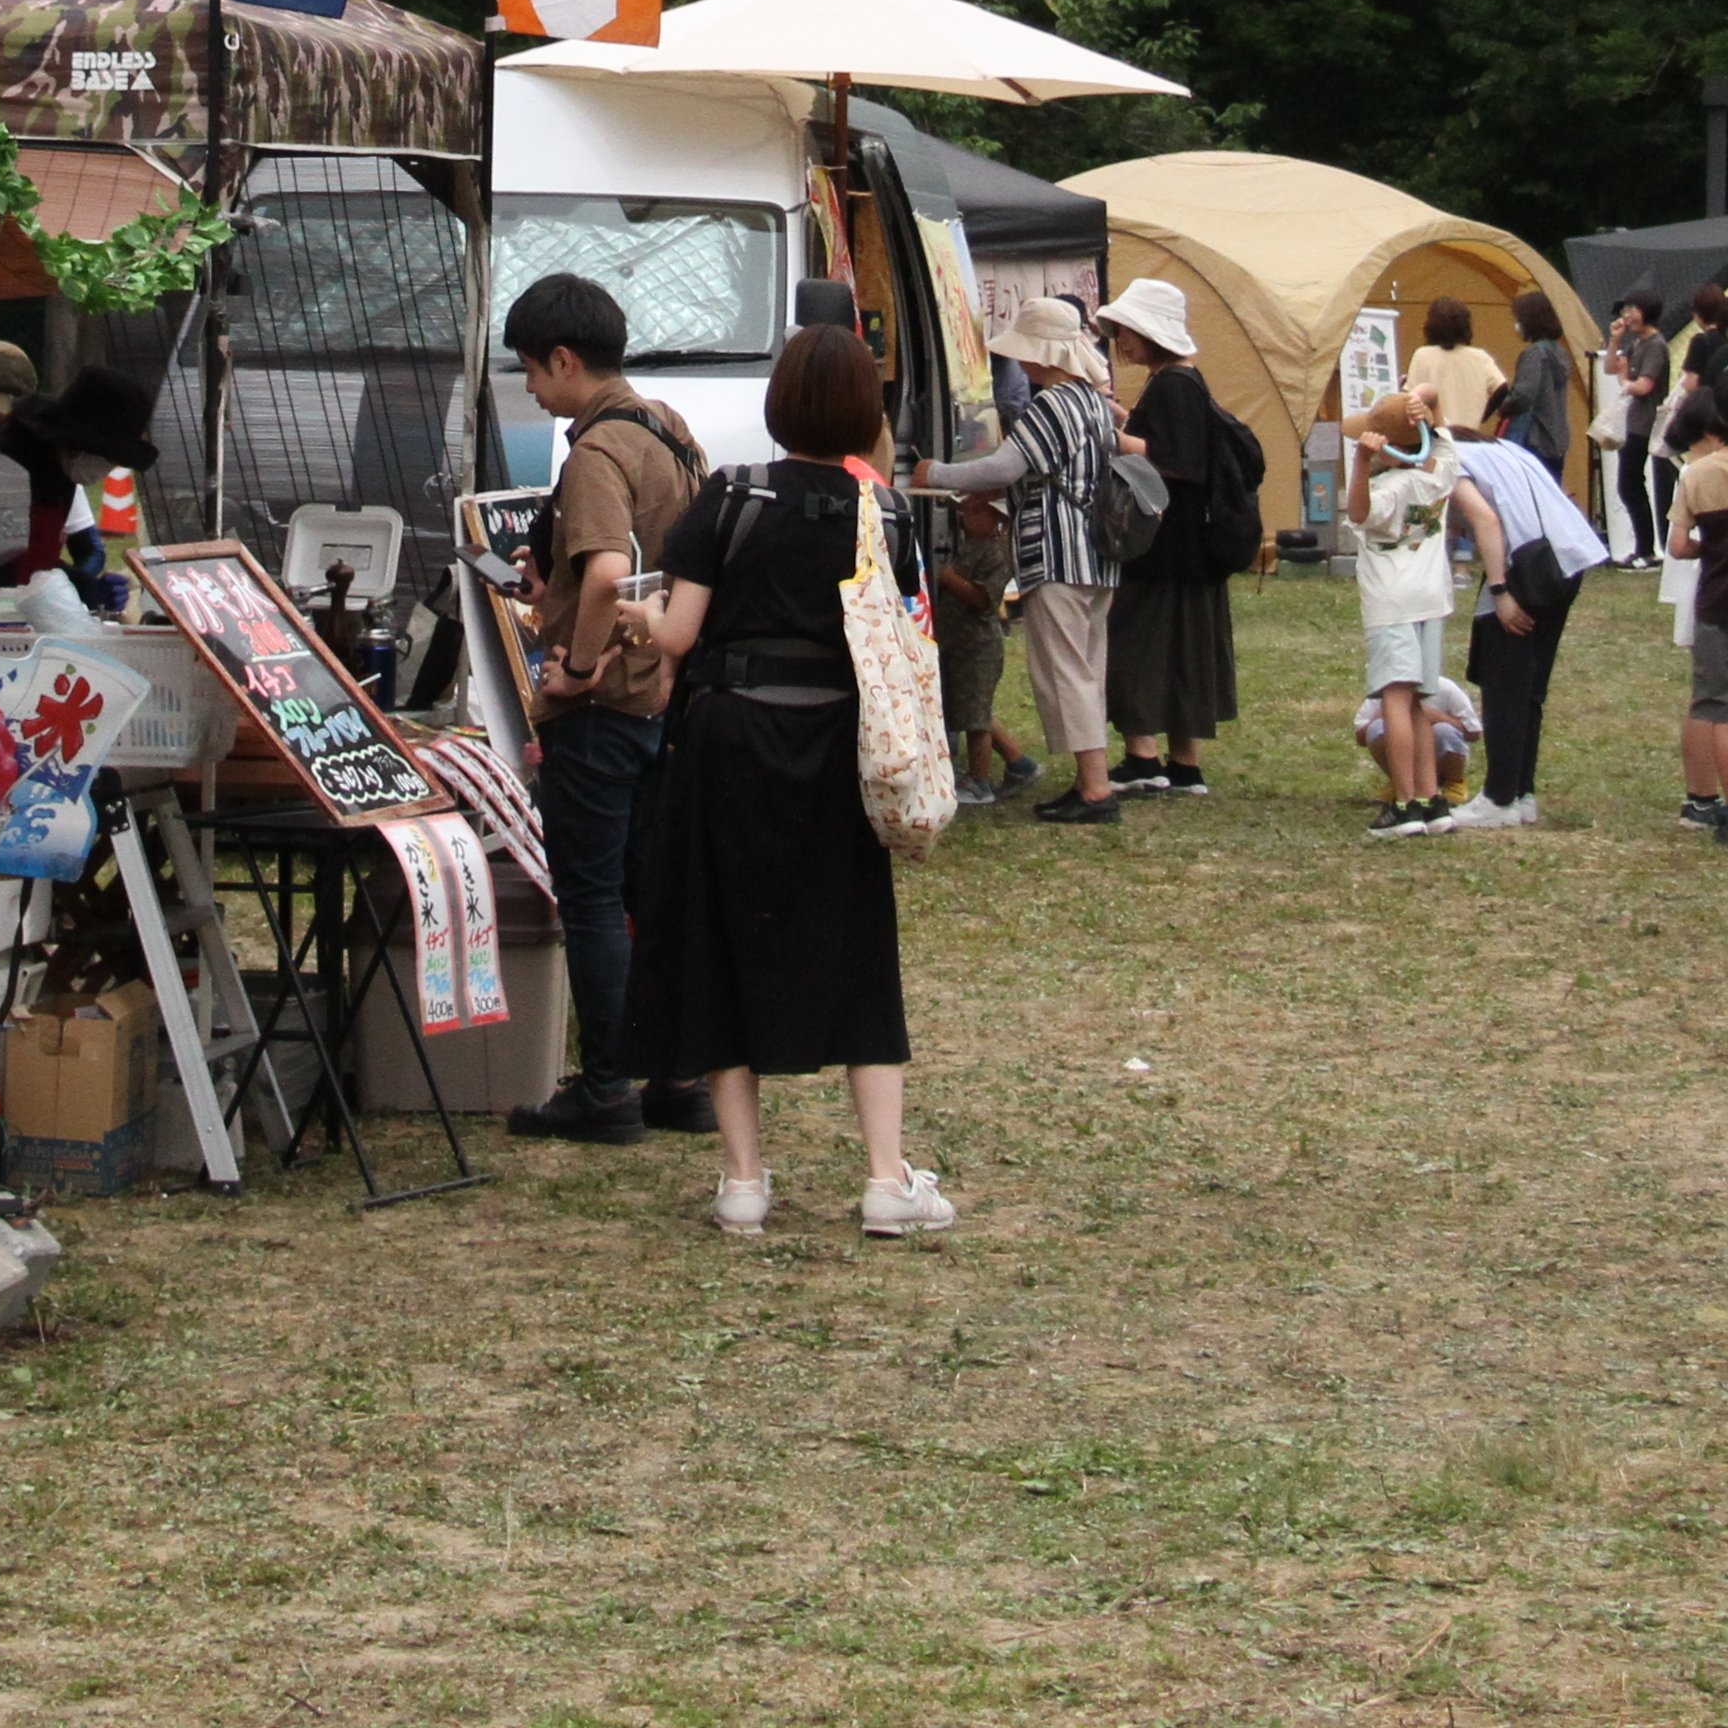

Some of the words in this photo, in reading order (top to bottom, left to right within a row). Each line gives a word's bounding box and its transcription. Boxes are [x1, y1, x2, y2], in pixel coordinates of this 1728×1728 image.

[71, 51, 157, 70] ENDLESS
[21, 672, 104, 764] 氷
[405, 841, 439, 929] かき氷
[451, 835, 484, 924] かき氷
